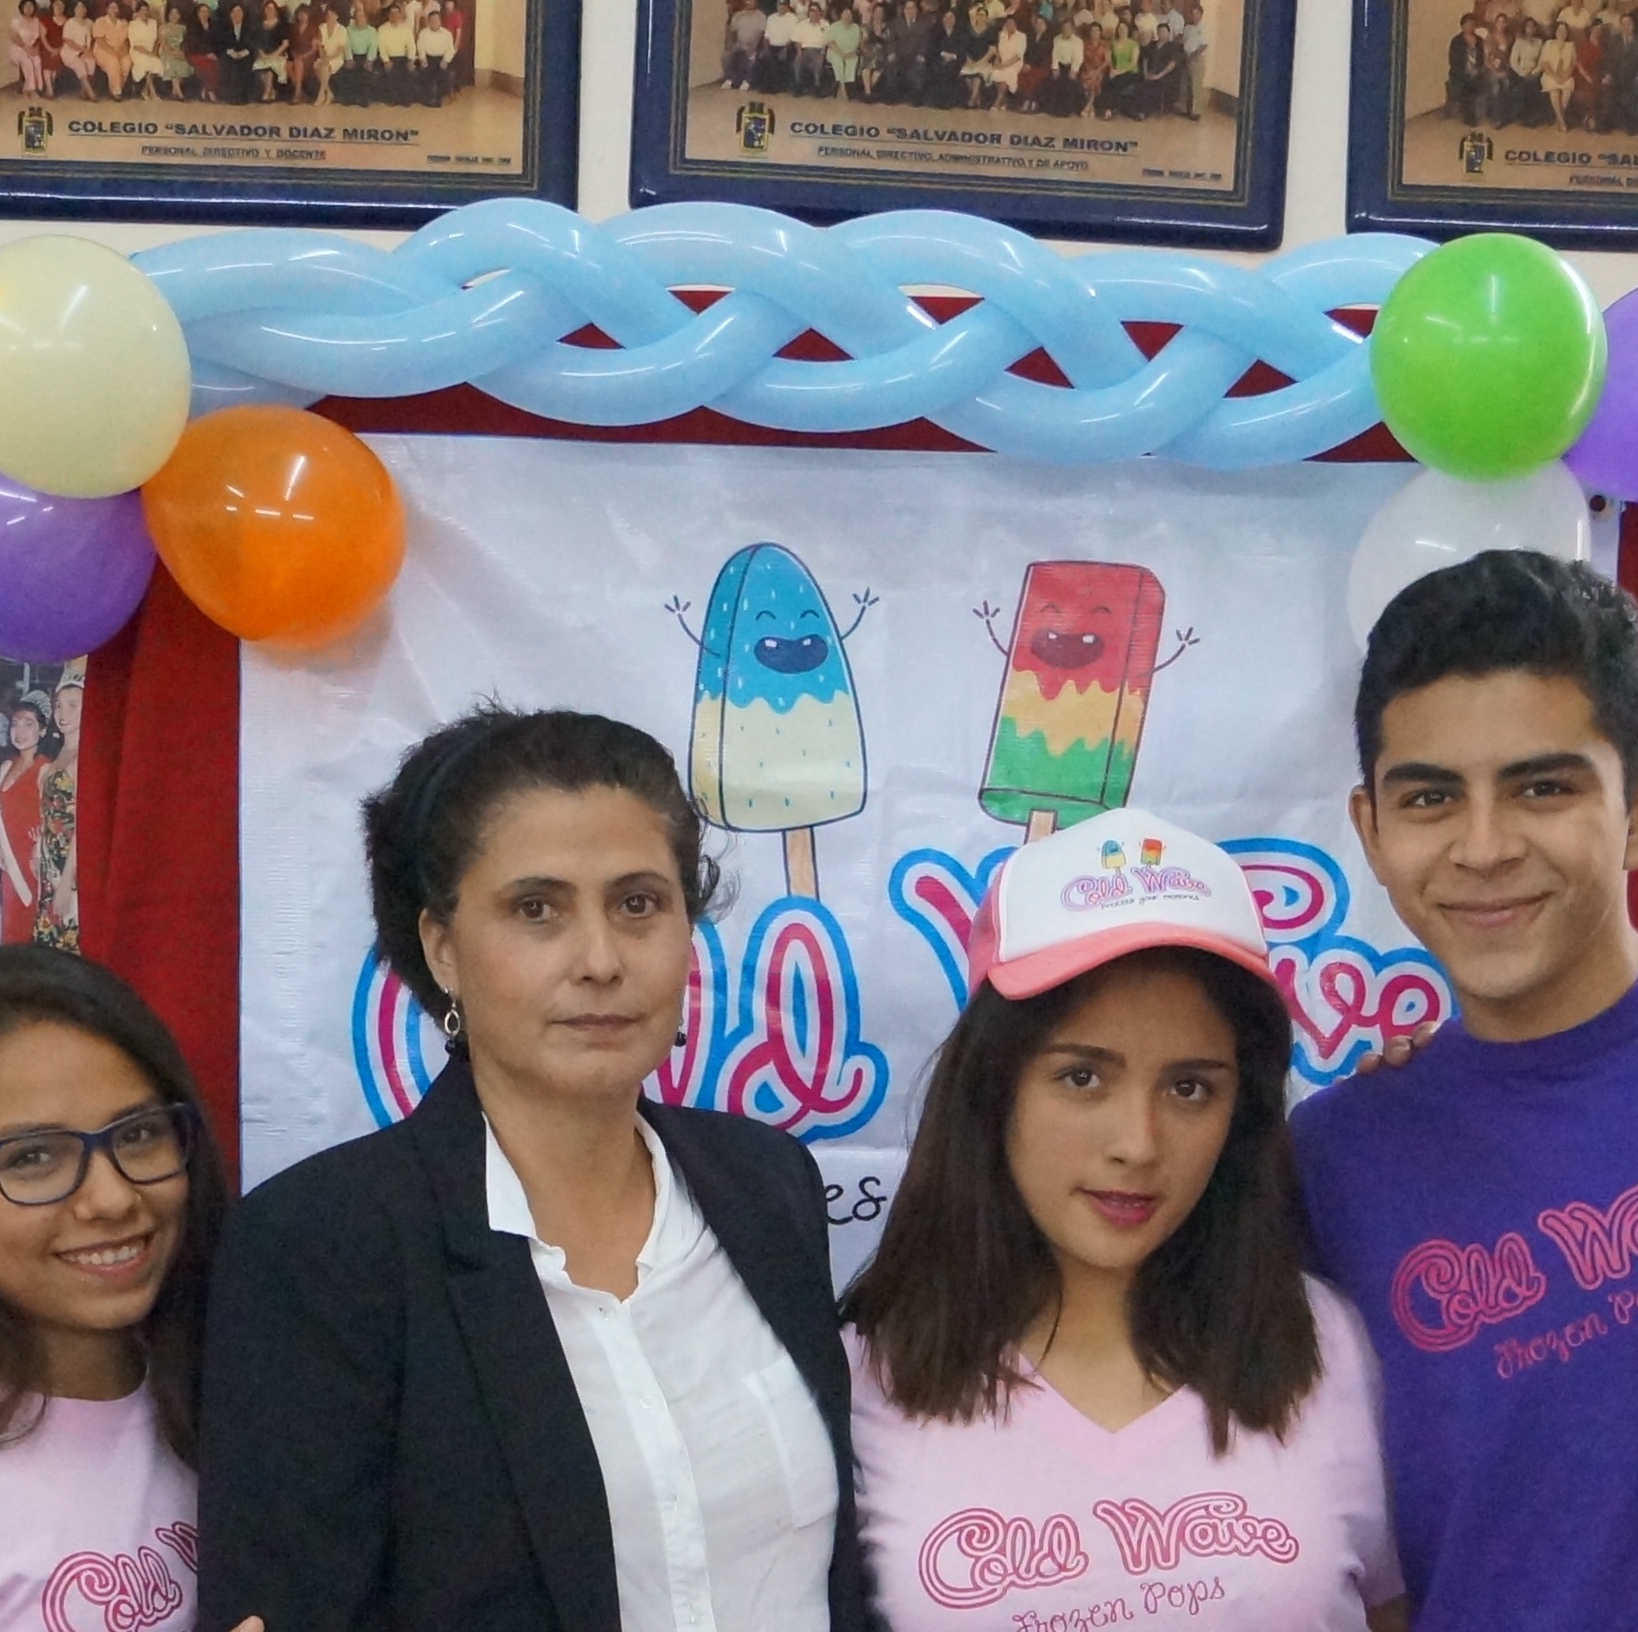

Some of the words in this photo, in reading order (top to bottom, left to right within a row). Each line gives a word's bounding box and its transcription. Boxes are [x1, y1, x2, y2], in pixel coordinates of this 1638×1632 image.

[67, 119, 159, 135] COLEGIO
[289, 126, 336, 140] DIAZ
[789, 120, 880, 138] COLEGIO
[1009, 132, 1056, 148] DIAZ
[1504, 149, 1592, 166] COLEGIO
[1060, 873, 1133, 912] Cold
[1391, 1231, 1547, 1353] Cold
[1495, 1312, 1609, 1379] Frozen
[918, 1506, 1090, 1611] Cold
[1092, 1490, 1301, 1577] Wave
[1140, 1576, 1227, 1616] Pops
